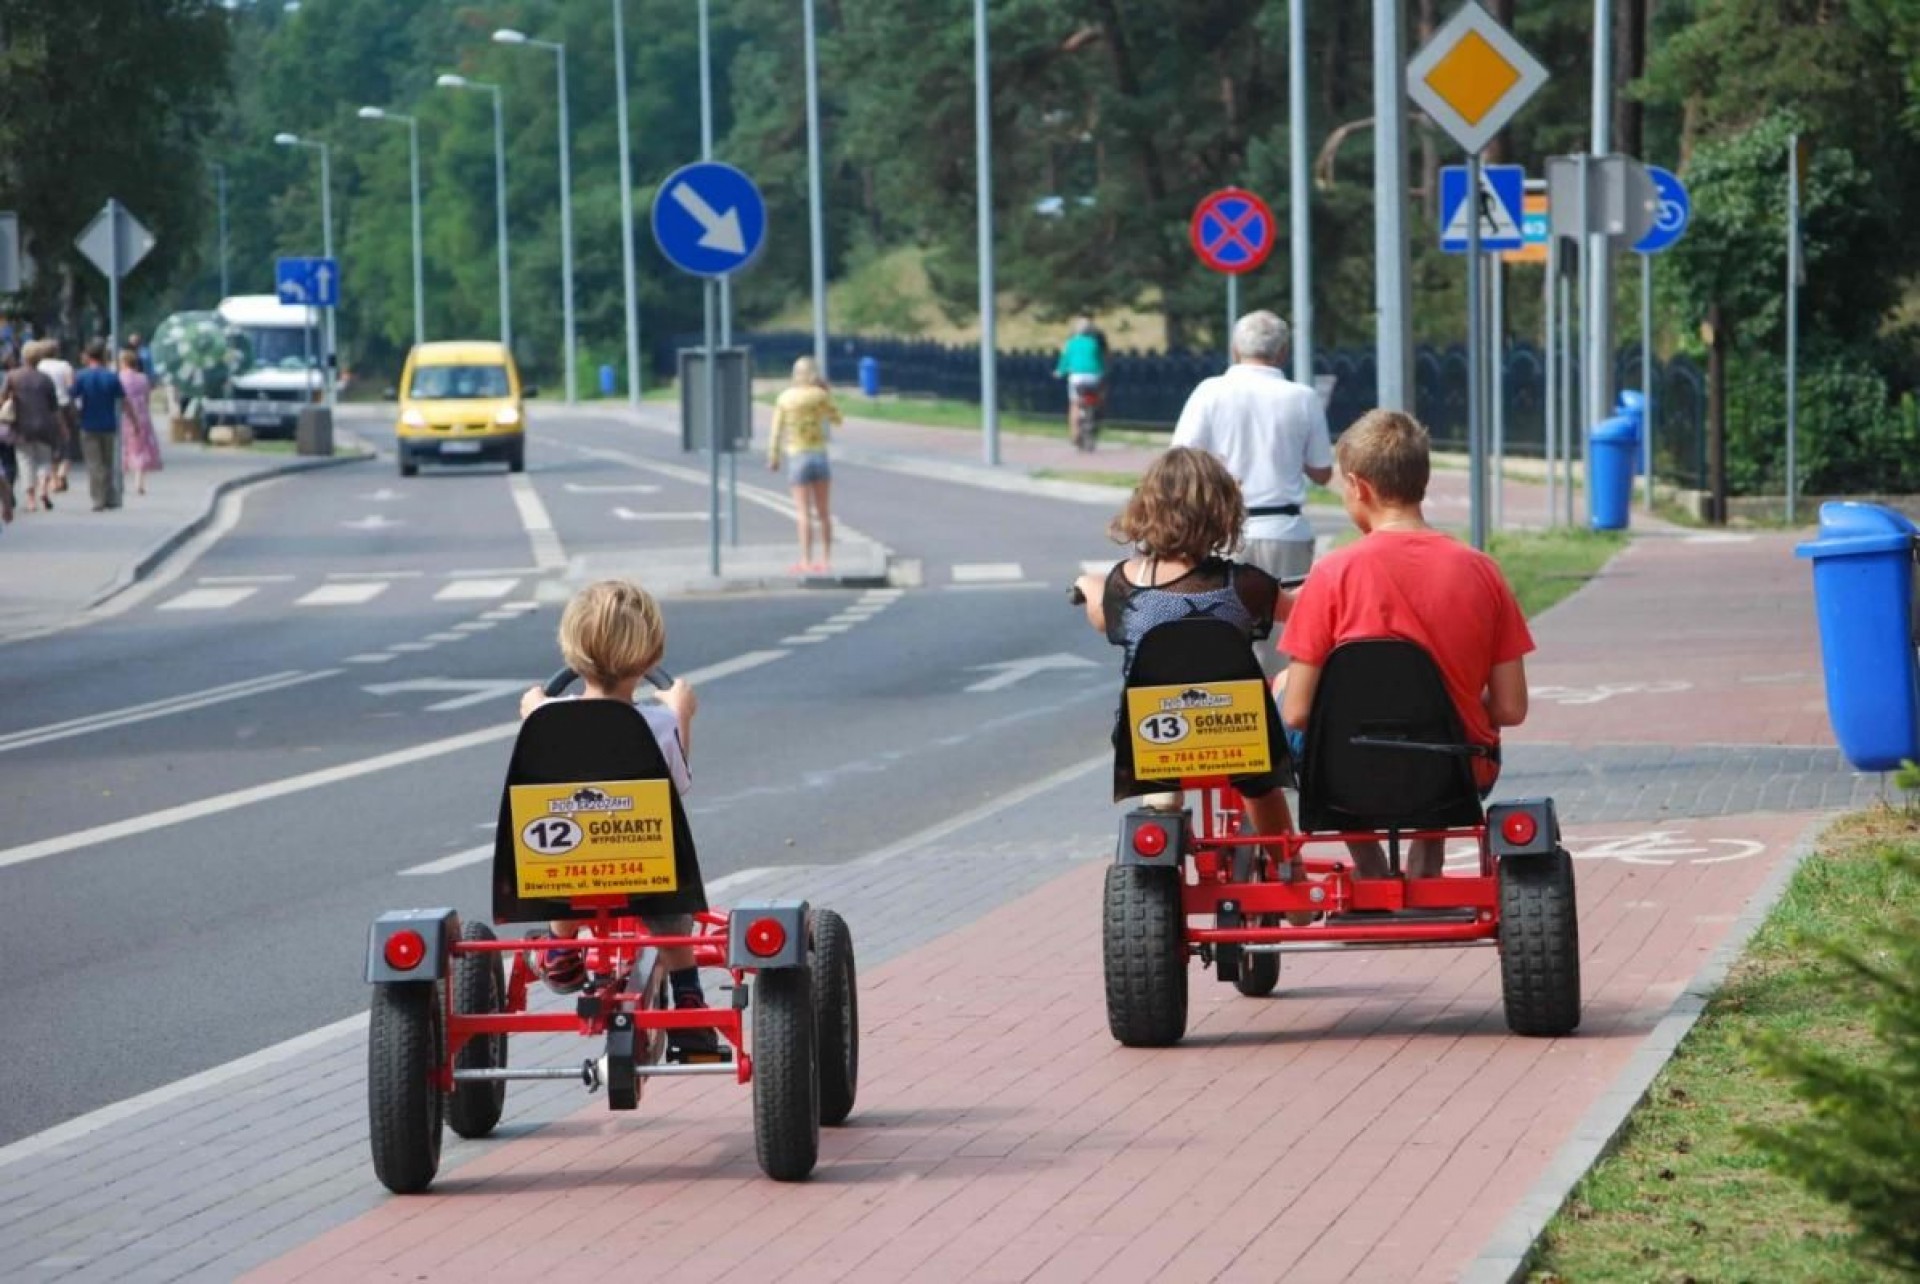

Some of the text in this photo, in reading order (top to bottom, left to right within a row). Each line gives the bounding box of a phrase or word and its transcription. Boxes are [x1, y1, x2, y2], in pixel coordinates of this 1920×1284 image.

[1195, 712, 1258, 727] GOKARTY
[1145, 717, 1180, 739] 13
[1175, 748, 1242, 762] 784 672 544
[531, 823, 572, 848] 12
[589, 819, 663, 836] GOKARTY
[565, 862, 643, 876] 784 672 544
